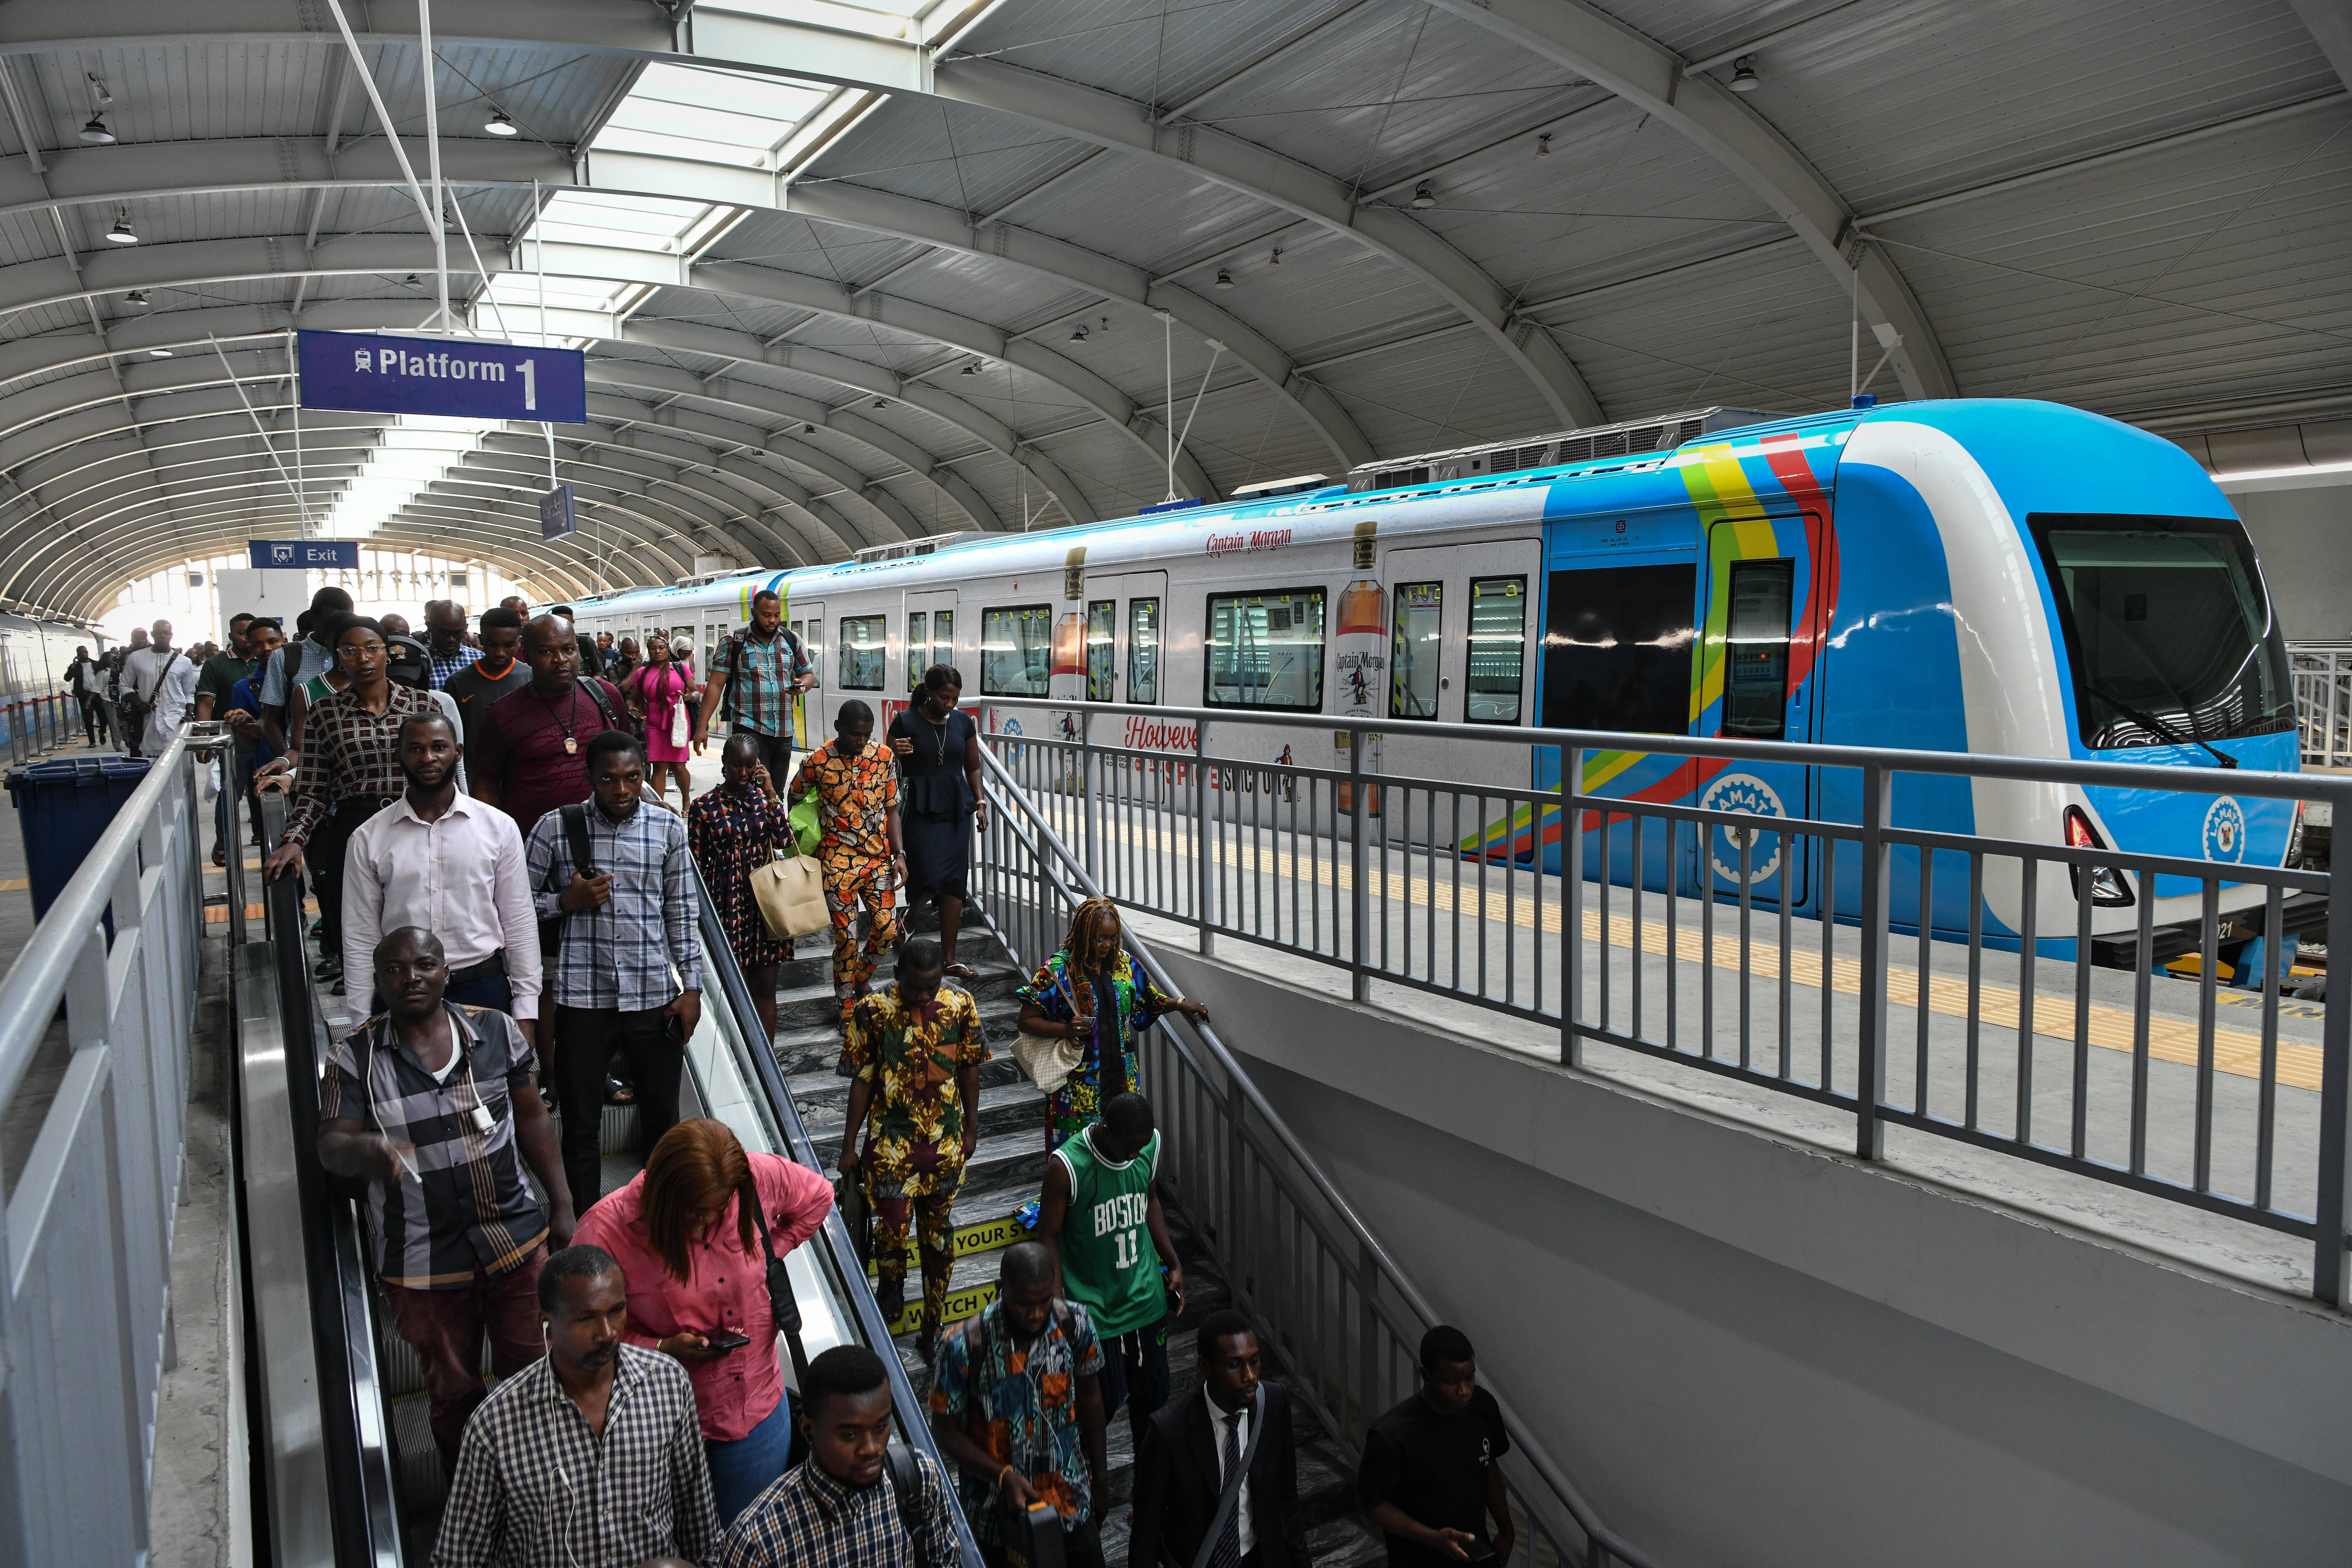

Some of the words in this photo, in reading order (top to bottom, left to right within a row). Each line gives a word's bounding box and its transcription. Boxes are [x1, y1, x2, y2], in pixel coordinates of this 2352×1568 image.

[380, 349, 505, 381] Platform
[515, 359, 536, 410] 1
[307, 549, 337, 561] Exit
[1206, 532, 1244, 558] Captain
[1247, 529, 1291, 555] Morgan
[1336, 651, 1358, 672] Captain
[1359, 651, 1385, 671] Morgan
[1007, 721, 1021, 734] AMAT
[1125, 716, 1197, 751] Howeve
[1719, 789, 1768, 814] AMAT
[2210, 808, 2239, 837] LAMATA
[1094, 1193, 1148, 1237] BOSTON
[956, 1227, 1005, 1250] YOUR
[1114, 1229, 1138, 1269] 11
[908, 1295, 977, 1323] WTCH
